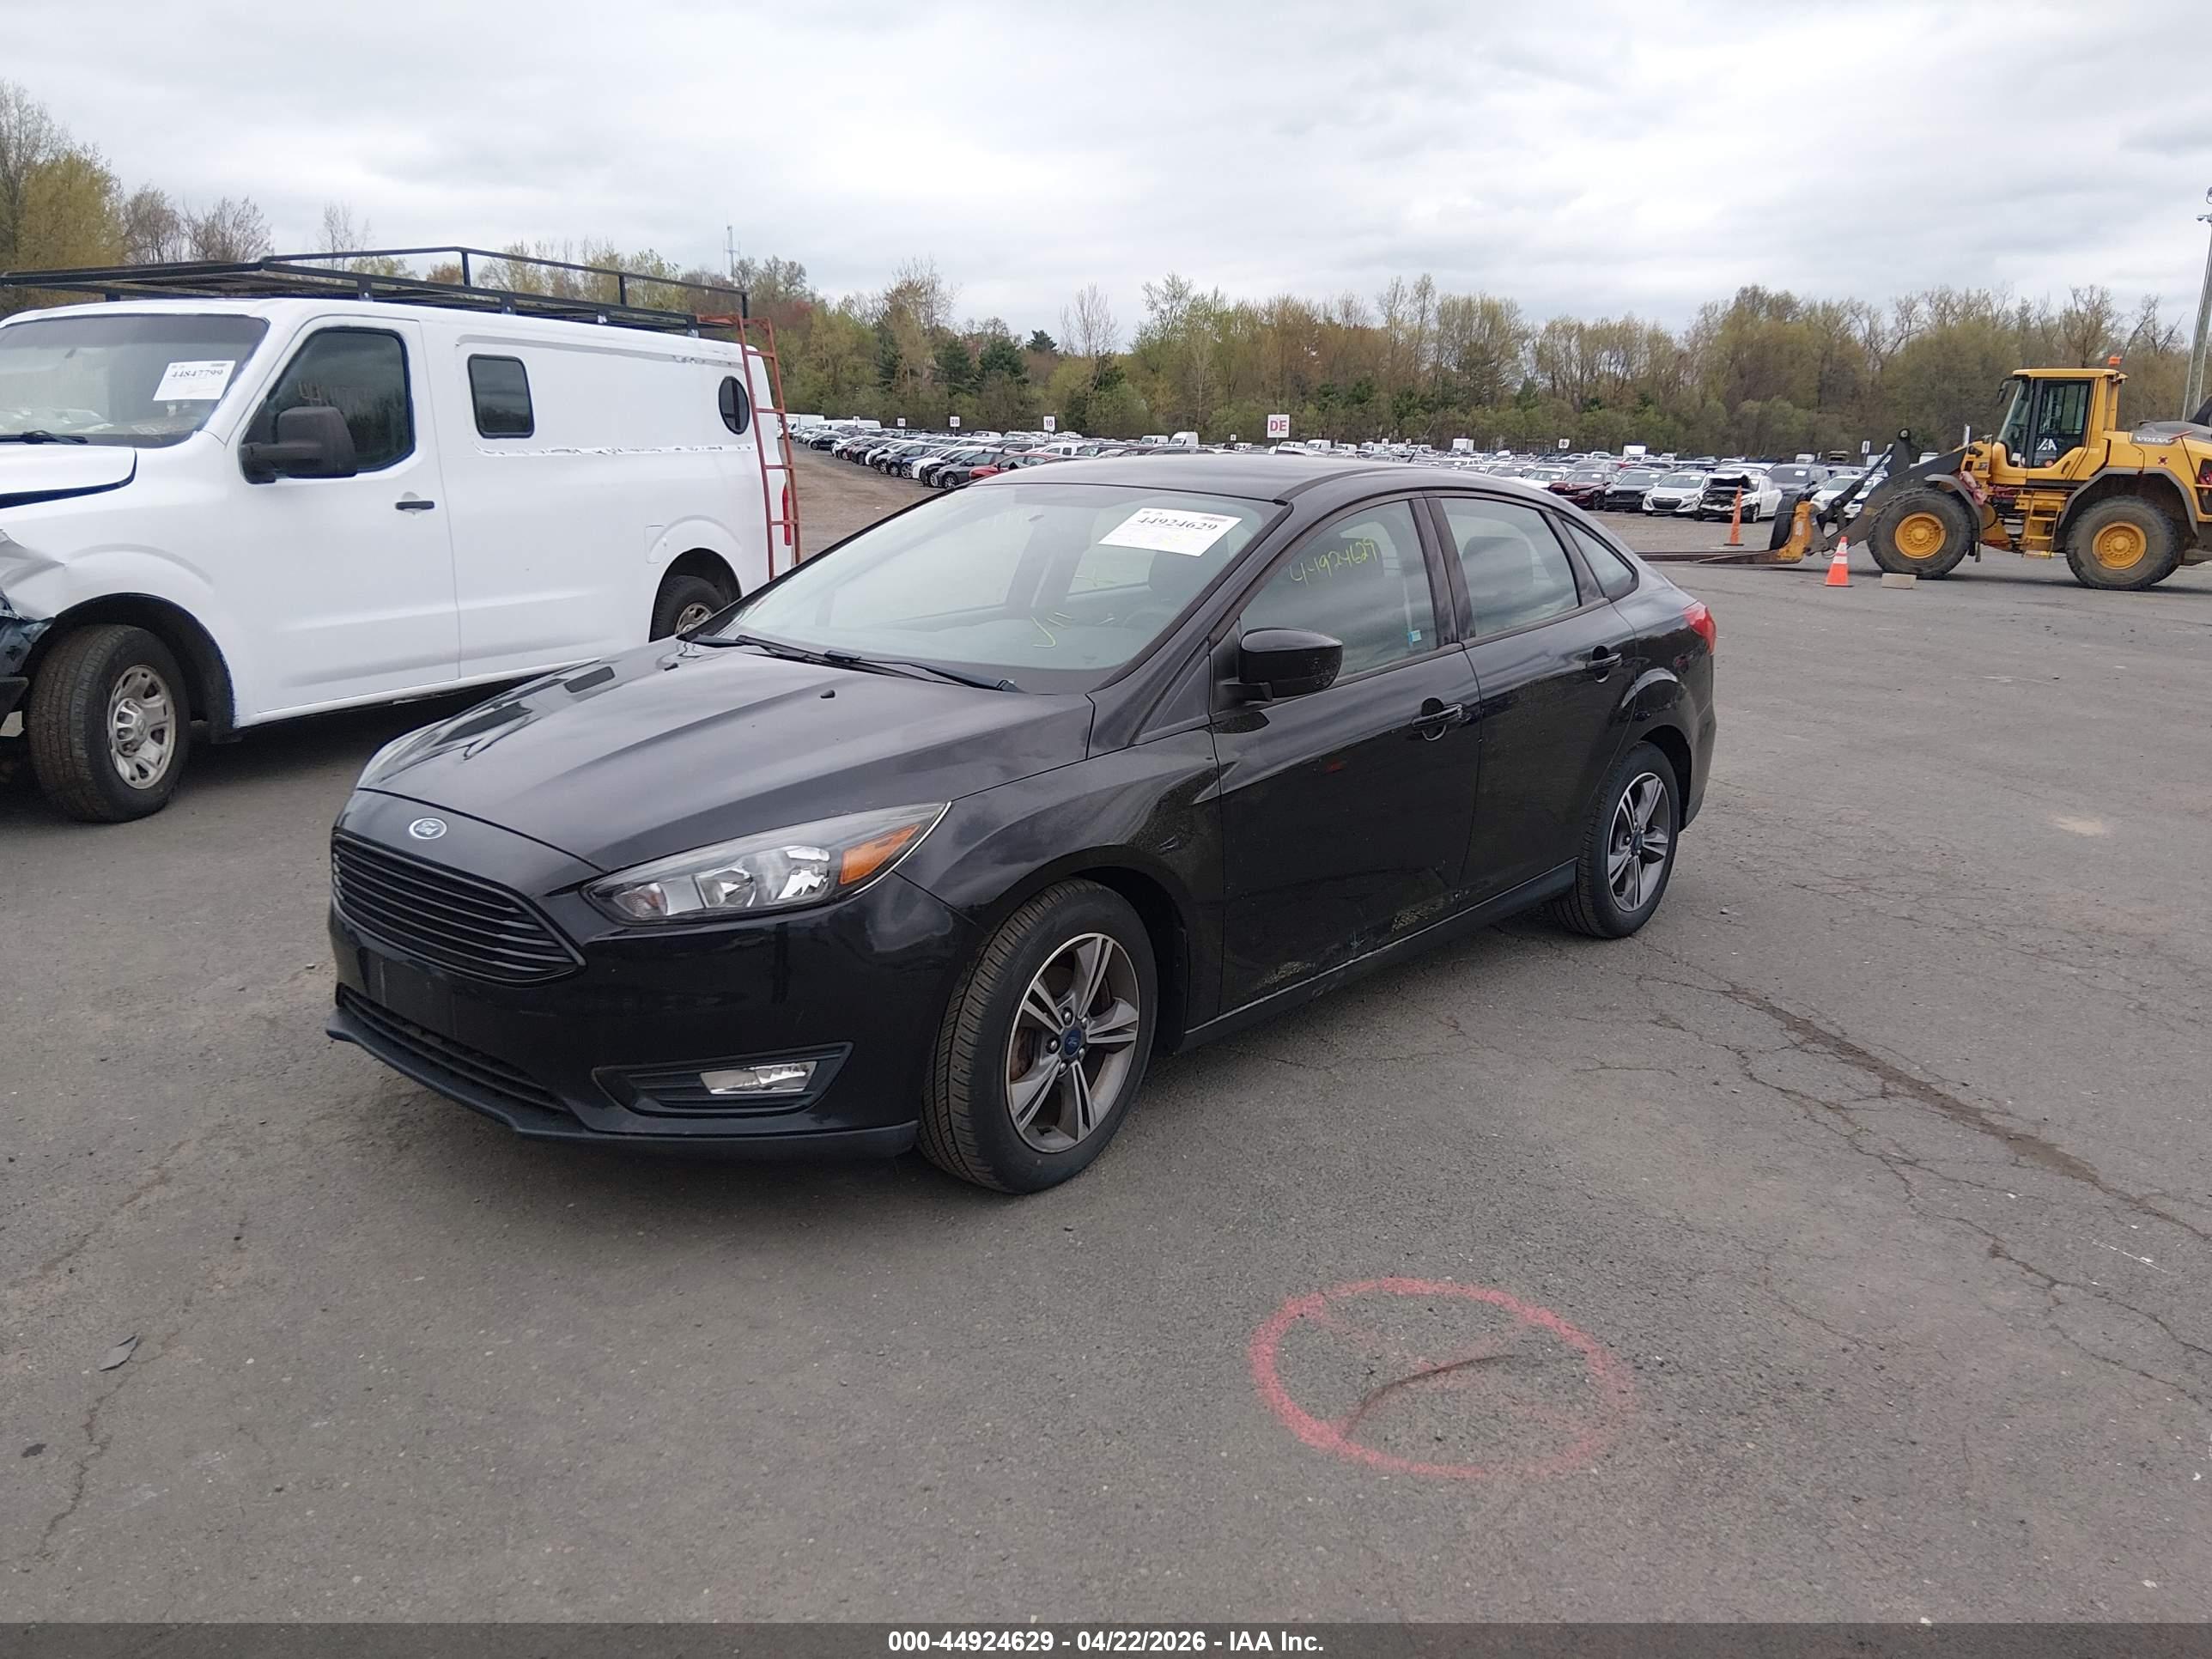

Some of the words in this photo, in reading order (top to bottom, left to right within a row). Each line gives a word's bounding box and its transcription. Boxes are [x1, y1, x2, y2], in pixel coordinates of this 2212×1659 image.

[1270, 420, 1287, 431] DE
[1136, 516, 1218, 531] 44924629
[415, 820, 440, 836] Ford
